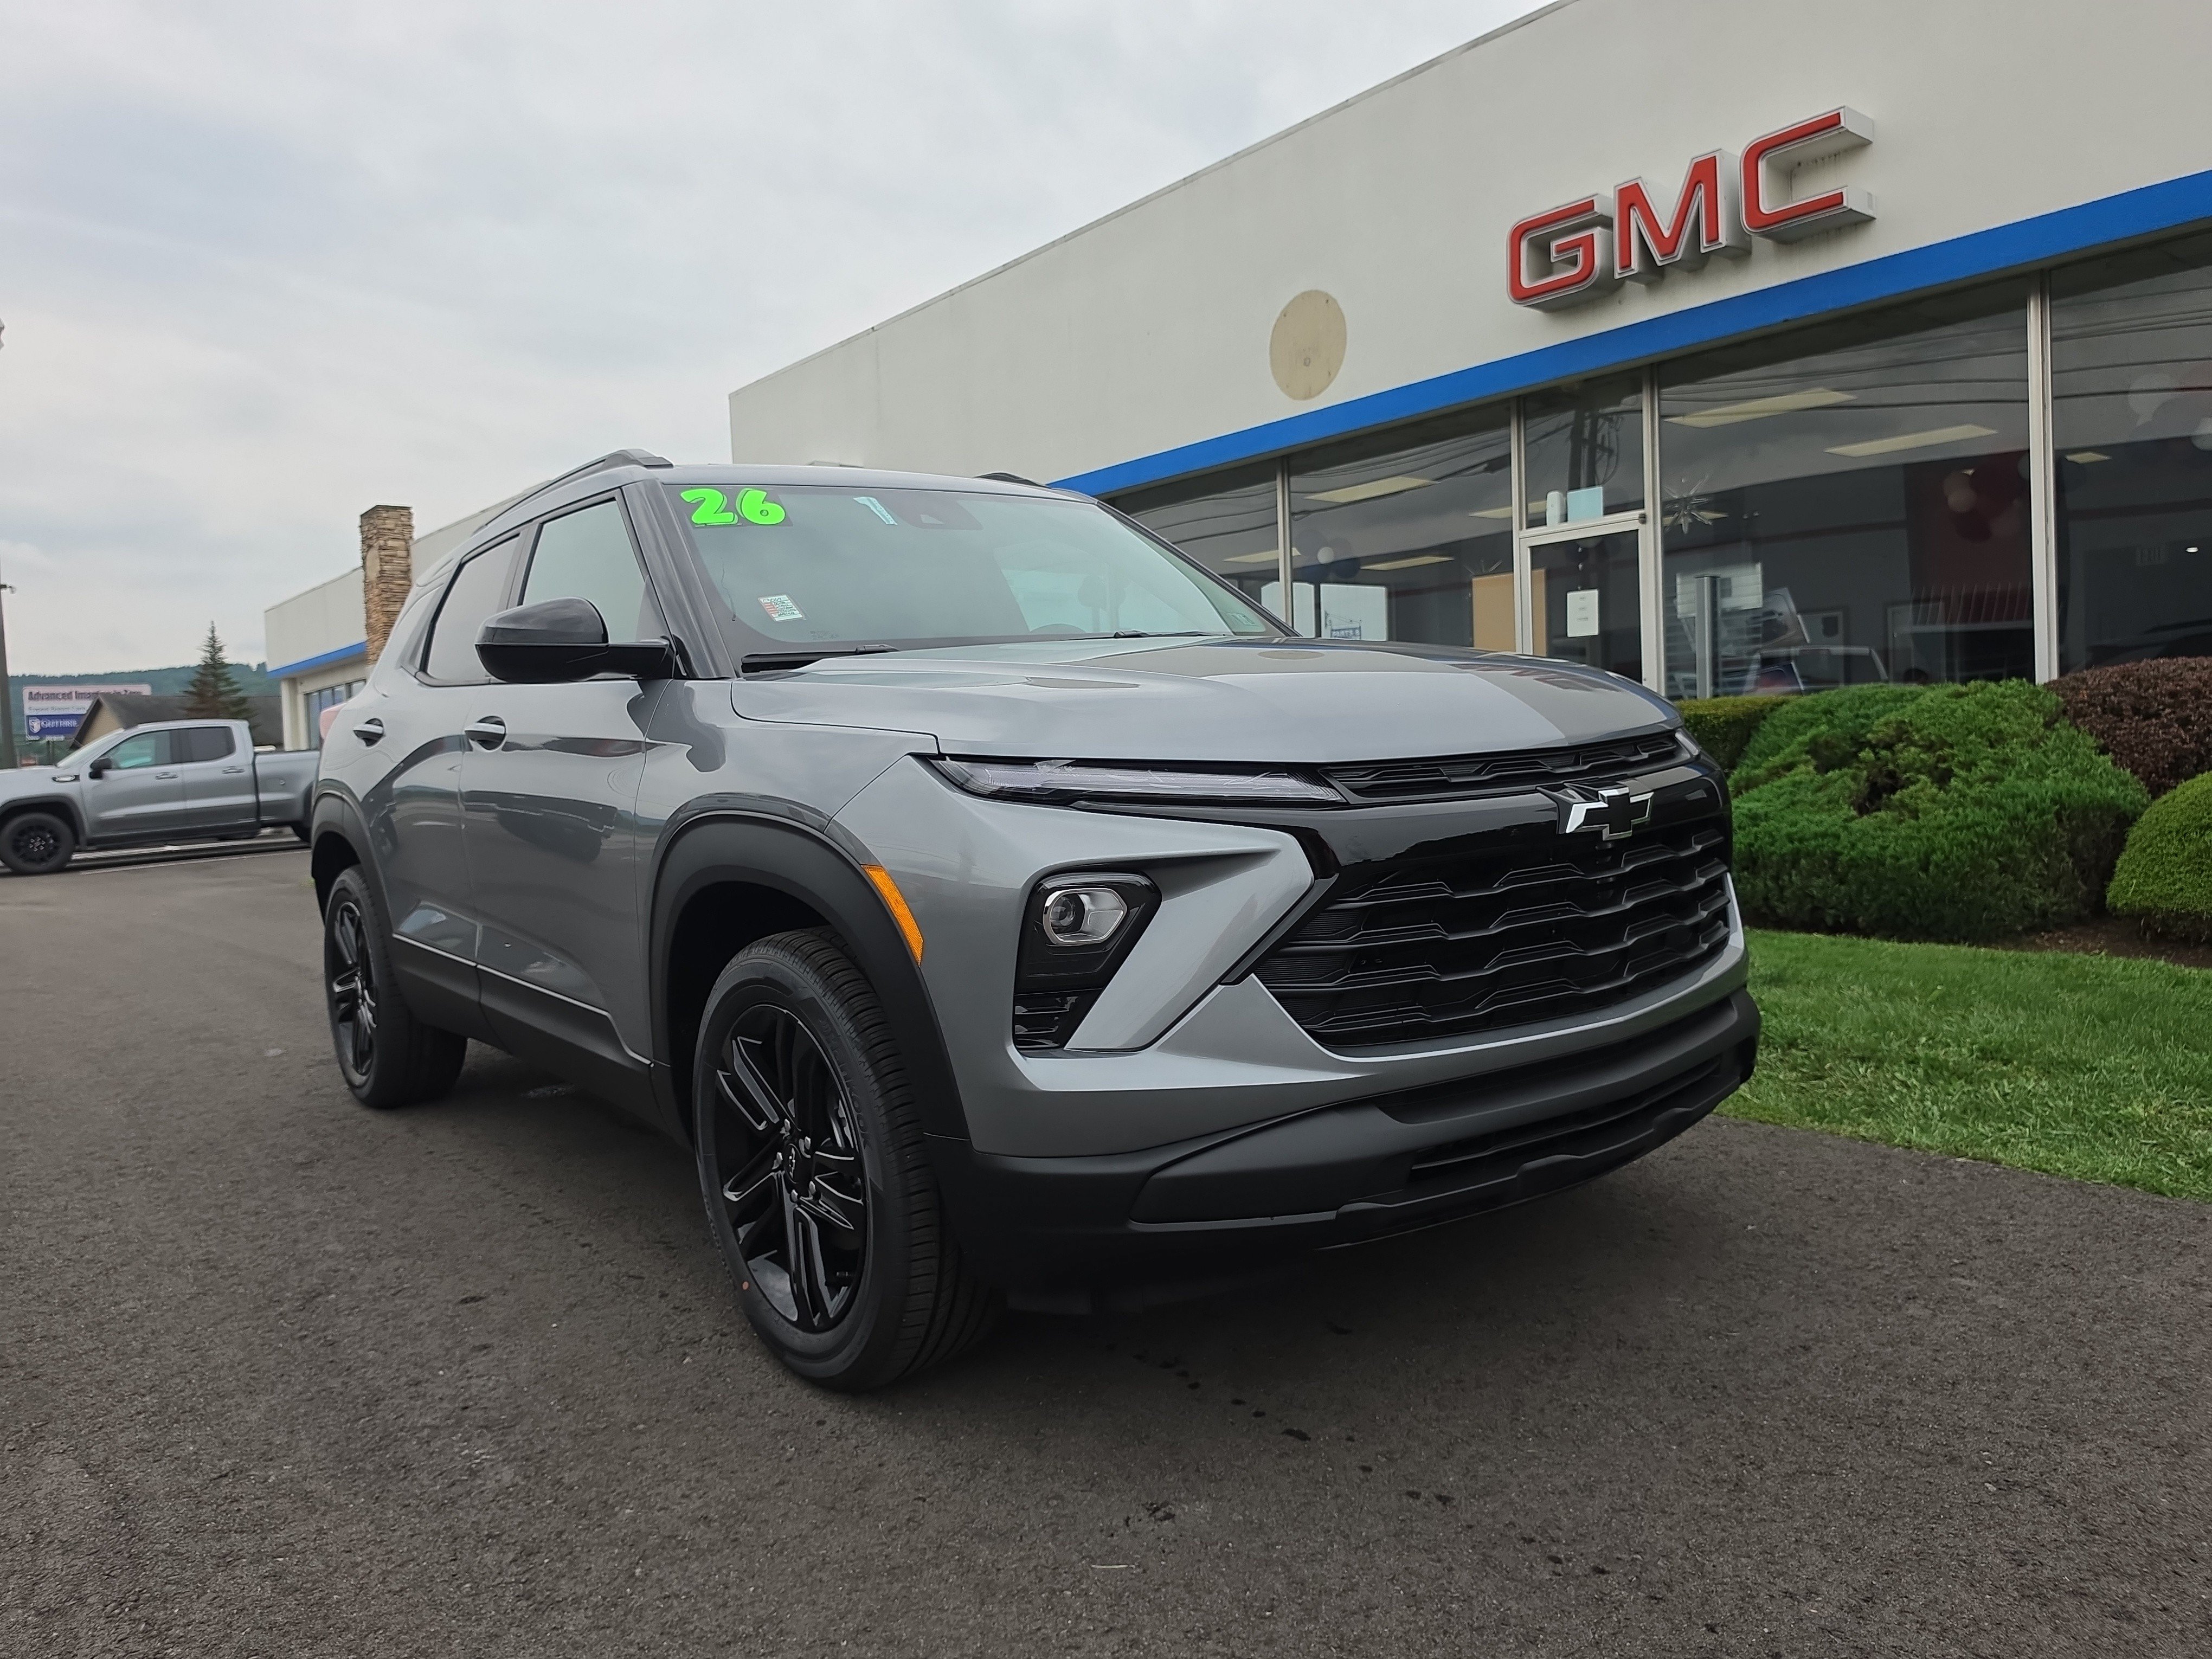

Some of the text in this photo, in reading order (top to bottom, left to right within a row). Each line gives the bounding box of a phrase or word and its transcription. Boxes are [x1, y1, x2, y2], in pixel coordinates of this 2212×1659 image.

[1506, 106, 1850, 305] GMC
[680, 488, 786, 525] 26
[28, 690, 73, 701] Advanced
